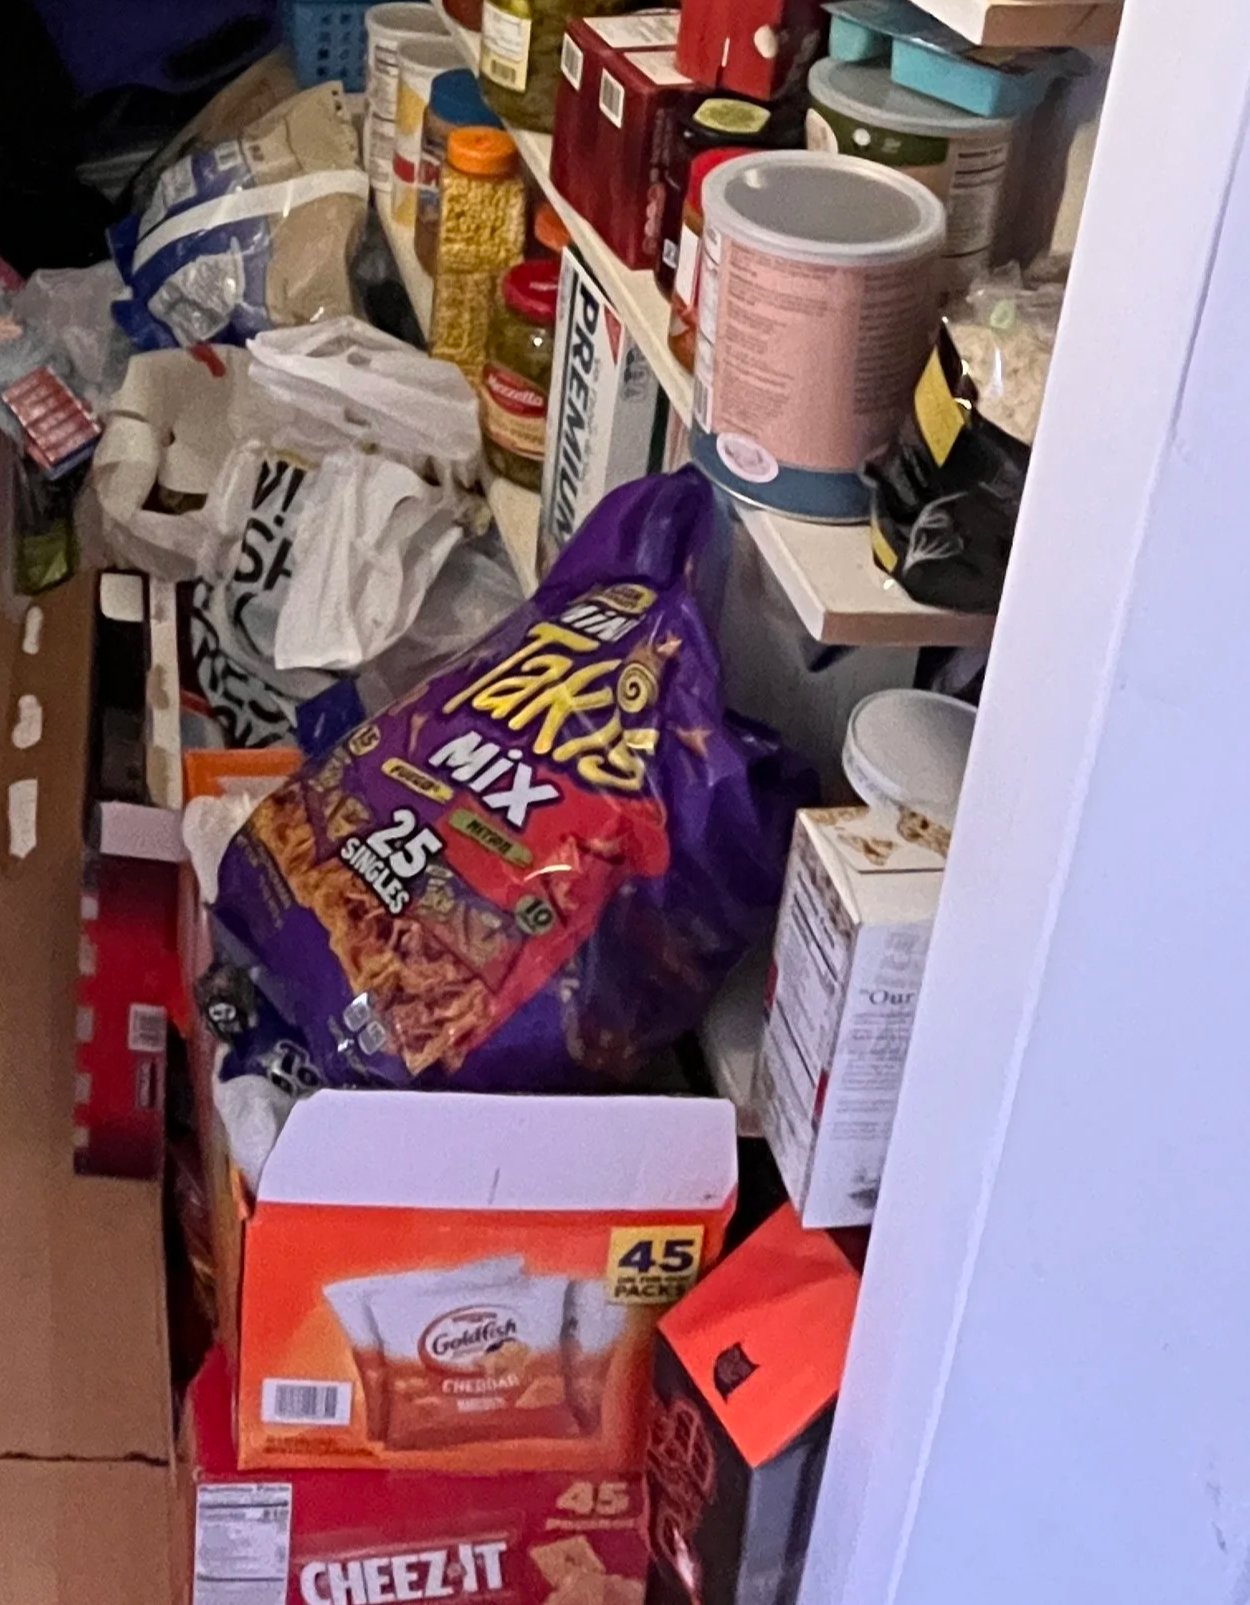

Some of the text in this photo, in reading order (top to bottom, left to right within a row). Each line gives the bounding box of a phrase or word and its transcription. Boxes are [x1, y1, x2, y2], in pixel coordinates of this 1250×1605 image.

[366, 809, 444, 879] 25
[340, 837, 410, 914] SINGLES
[617, 1238, 696, 1274] 45
[614, 1283, 686, 1299] PACKS
[431, 1317, 517, 1356] Goldfish
[556, 1481, 629, 1515] 45
